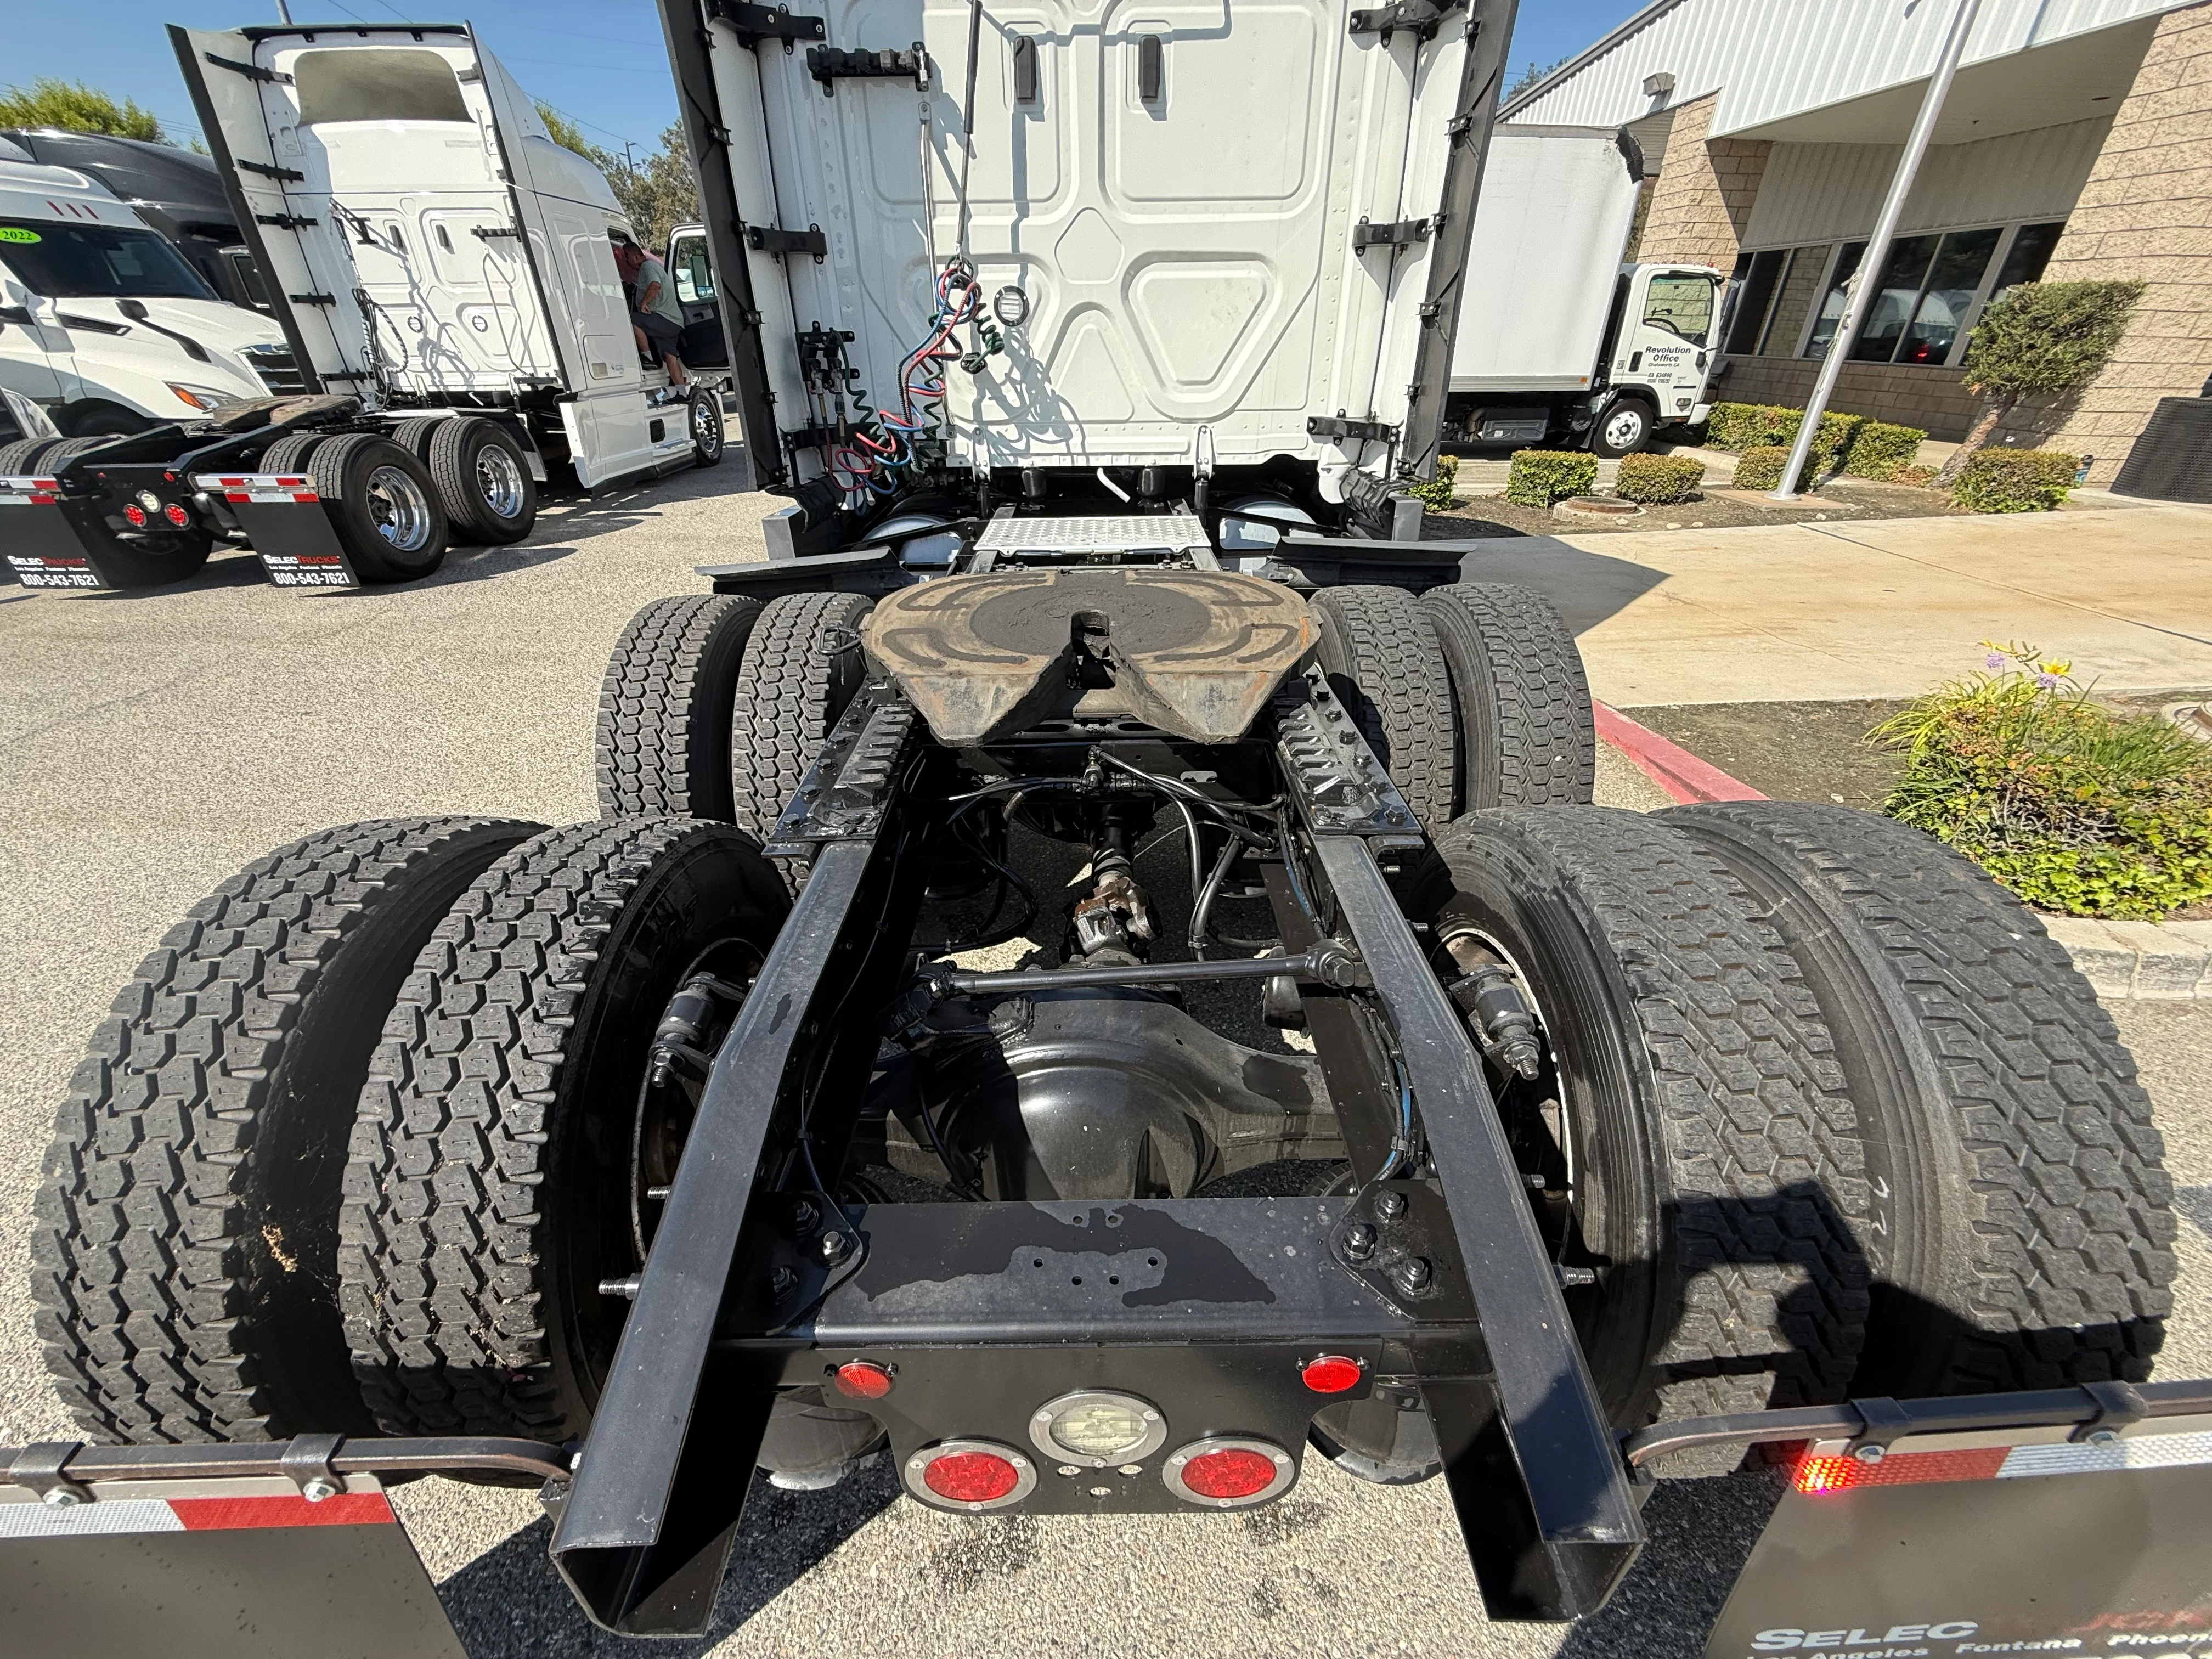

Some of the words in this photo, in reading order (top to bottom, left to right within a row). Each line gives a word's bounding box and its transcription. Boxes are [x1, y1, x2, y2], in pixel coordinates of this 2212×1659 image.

[2, 230, 32, 240] 2022
[20, 574, 100, 586] 800-543-7621
[273, 572, 350, 584] 800-543-7621
[1955, 1639, 2082, 1654] Fontana
